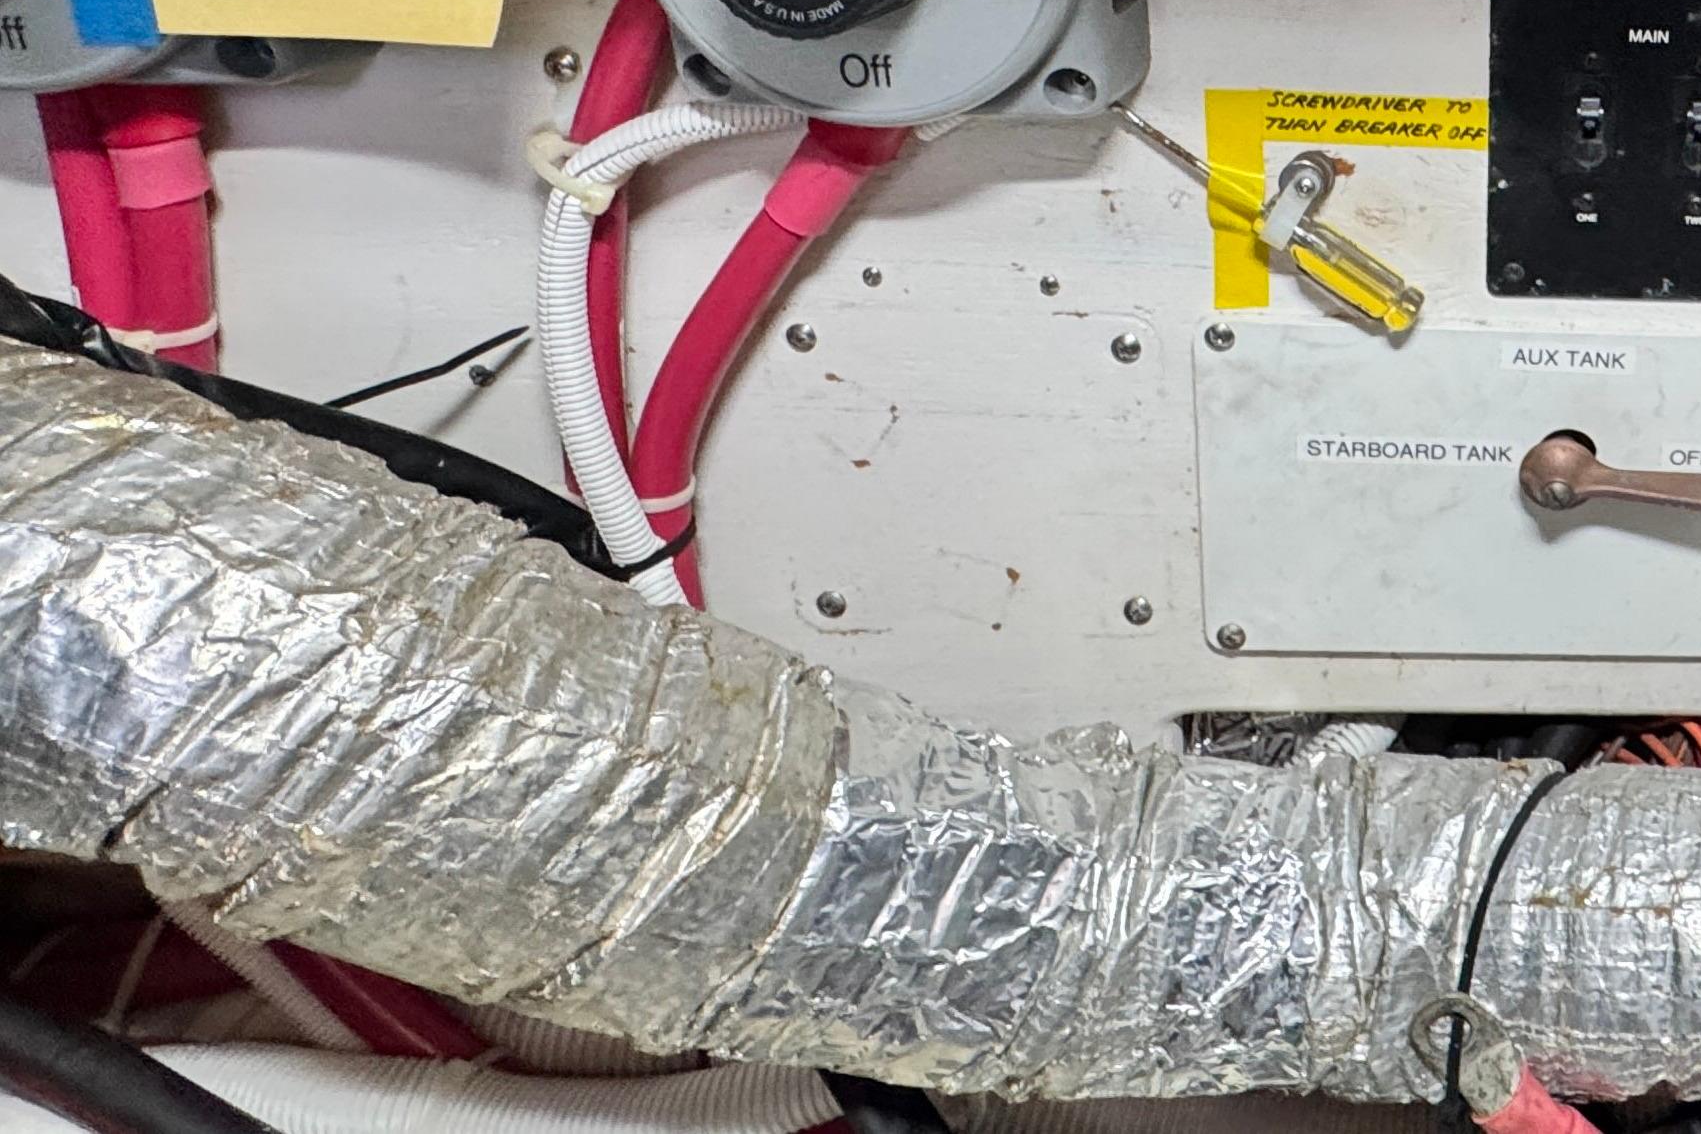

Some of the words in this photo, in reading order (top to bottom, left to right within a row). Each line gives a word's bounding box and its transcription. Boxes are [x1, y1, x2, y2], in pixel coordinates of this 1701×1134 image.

[790, 10, 805, 22] IN
[0, 16, 27, 50] ff
[1628, 29, 1670, 44] MAIN
[839, 53, 893, 89] Off
[1266, 91, 1427, 114] SCREWDRIVER
[1446, 99, 1472, 114] TO
[1265, 116, 1327, 133] TURN
[1335, 119, 1442, 139] BREAKER
[1448, 126, 1487, 141] OFF
[1576, 213, 1598, 224] ONE
[1512, 348, 1560, 367] AUX
[1565, 350, 1627, 369] TANK
[1306, 439, 1447, 460] STARBOARD
[1453, 445, 1513, 463] TANK
